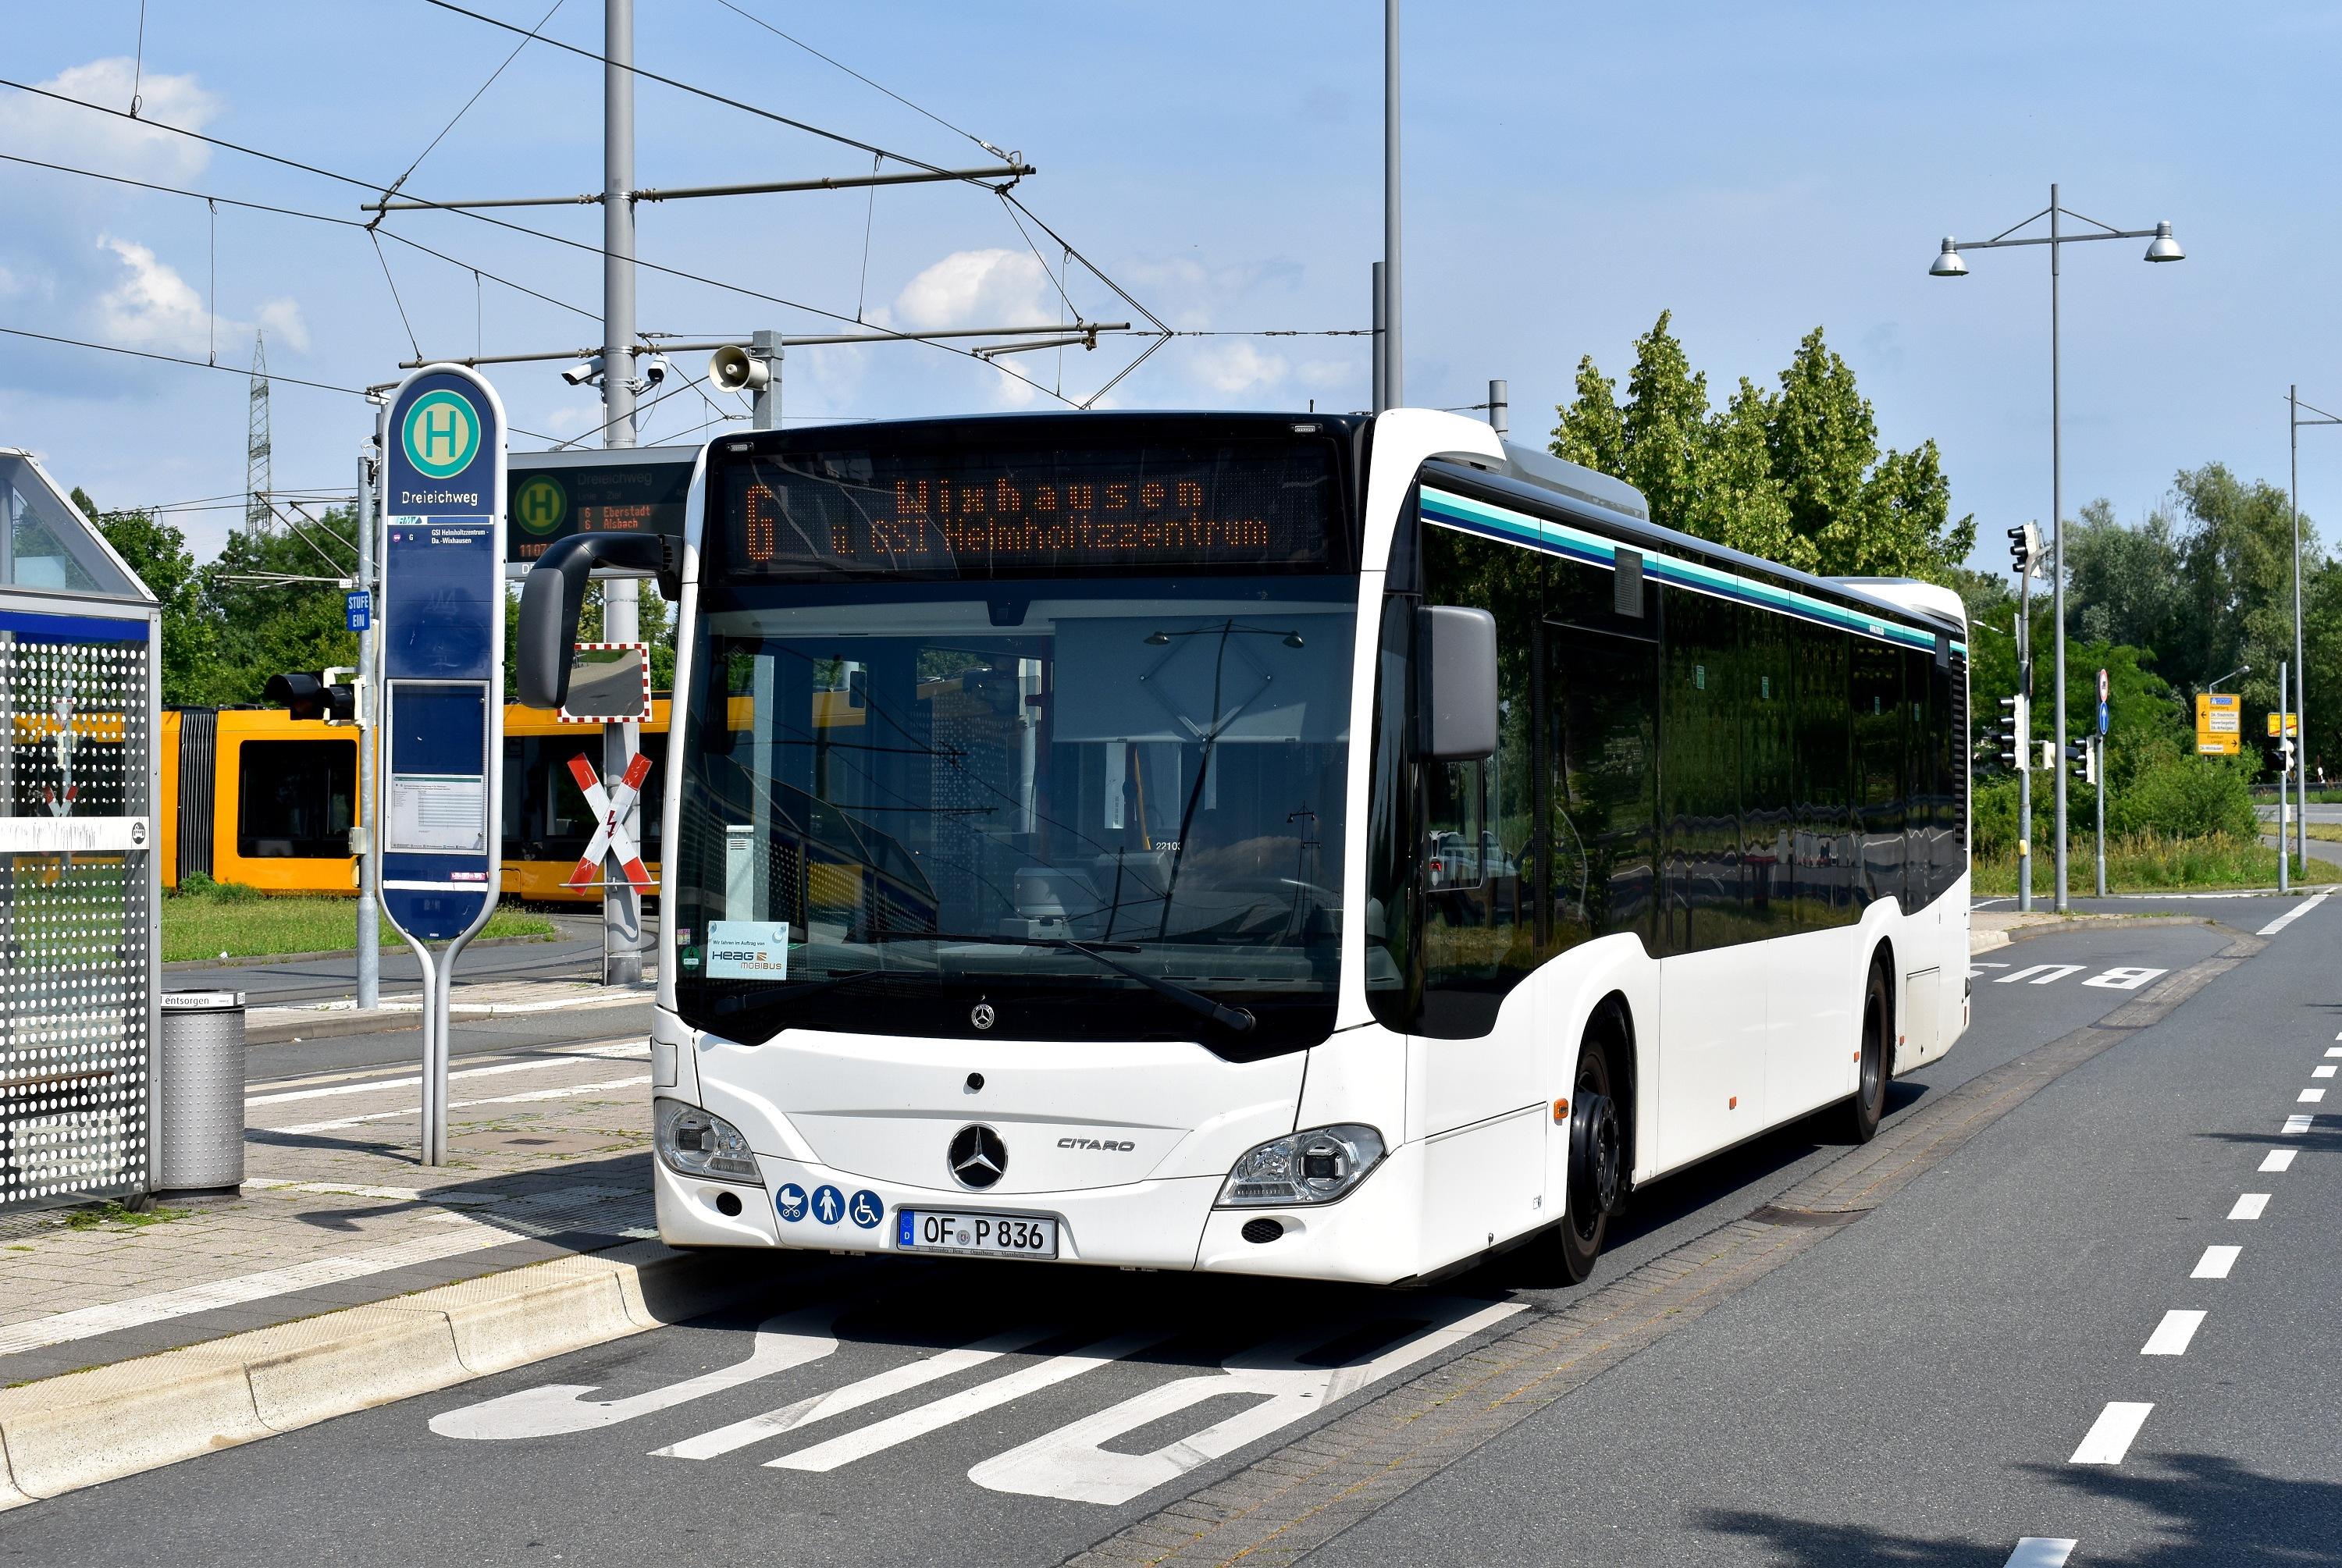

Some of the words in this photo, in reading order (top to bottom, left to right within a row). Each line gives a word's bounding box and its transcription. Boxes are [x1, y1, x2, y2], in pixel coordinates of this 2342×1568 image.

[426, 411, 456, 458] H
[401, 490, 479, 507] Dreieichweg
[897, 478, 1202, 514] Wixhausen
[529, 489, 553, 521] H
[585, 507, 591, 518] 6
[603, 505, 650, 517] Eberstadt
[584, 519, 591, 530] 6
[603, 517, 638, 530] Alsbach
[872, 520, 927, 553] GSI
[945, 511, 1267, 551] Helmholtzzentrum
[348, 596, 368, 610] STUFE
[353, 614, 365, 627] EIN
[688, 947, 694, 958] 4
[166, 996, 209, 1007] entsorgen
[1056, 1137, 1136, 1152] CITARO
[924, 1216, 956, 1244] OF
[975, 1219, 991, 1245] P
[997, 1221, 1044, 1250] 836
